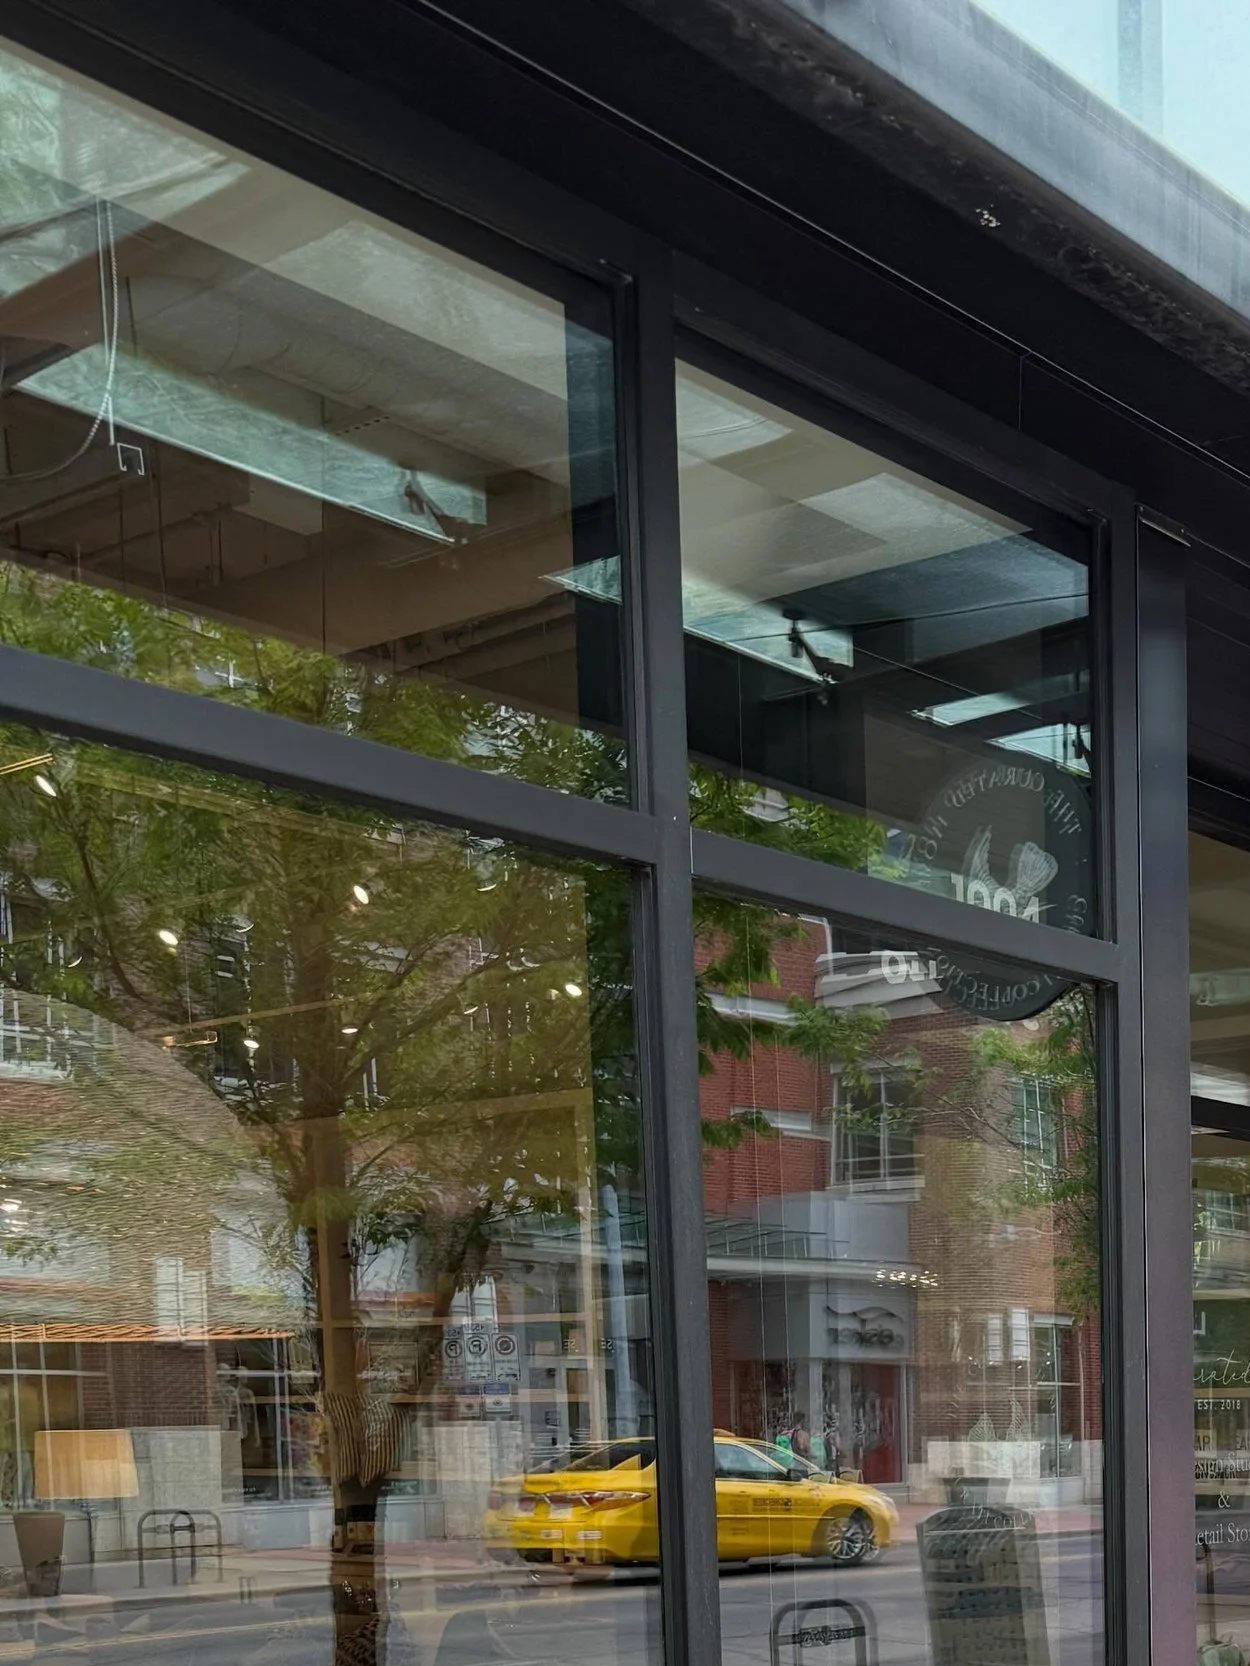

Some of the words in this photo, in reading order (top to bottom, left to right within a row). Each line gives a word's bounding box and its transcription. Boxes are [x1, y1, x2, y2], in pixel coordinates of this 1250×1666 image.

[1197, 1400, 1217, 1410] EST.
[1221, 1400, 1241, 1410] 2018
[1195, 1457, 1224, 1477] sign
[1217, 1490, 1230, 1508] &
[1195, 1523, 1223, 1545] etail
